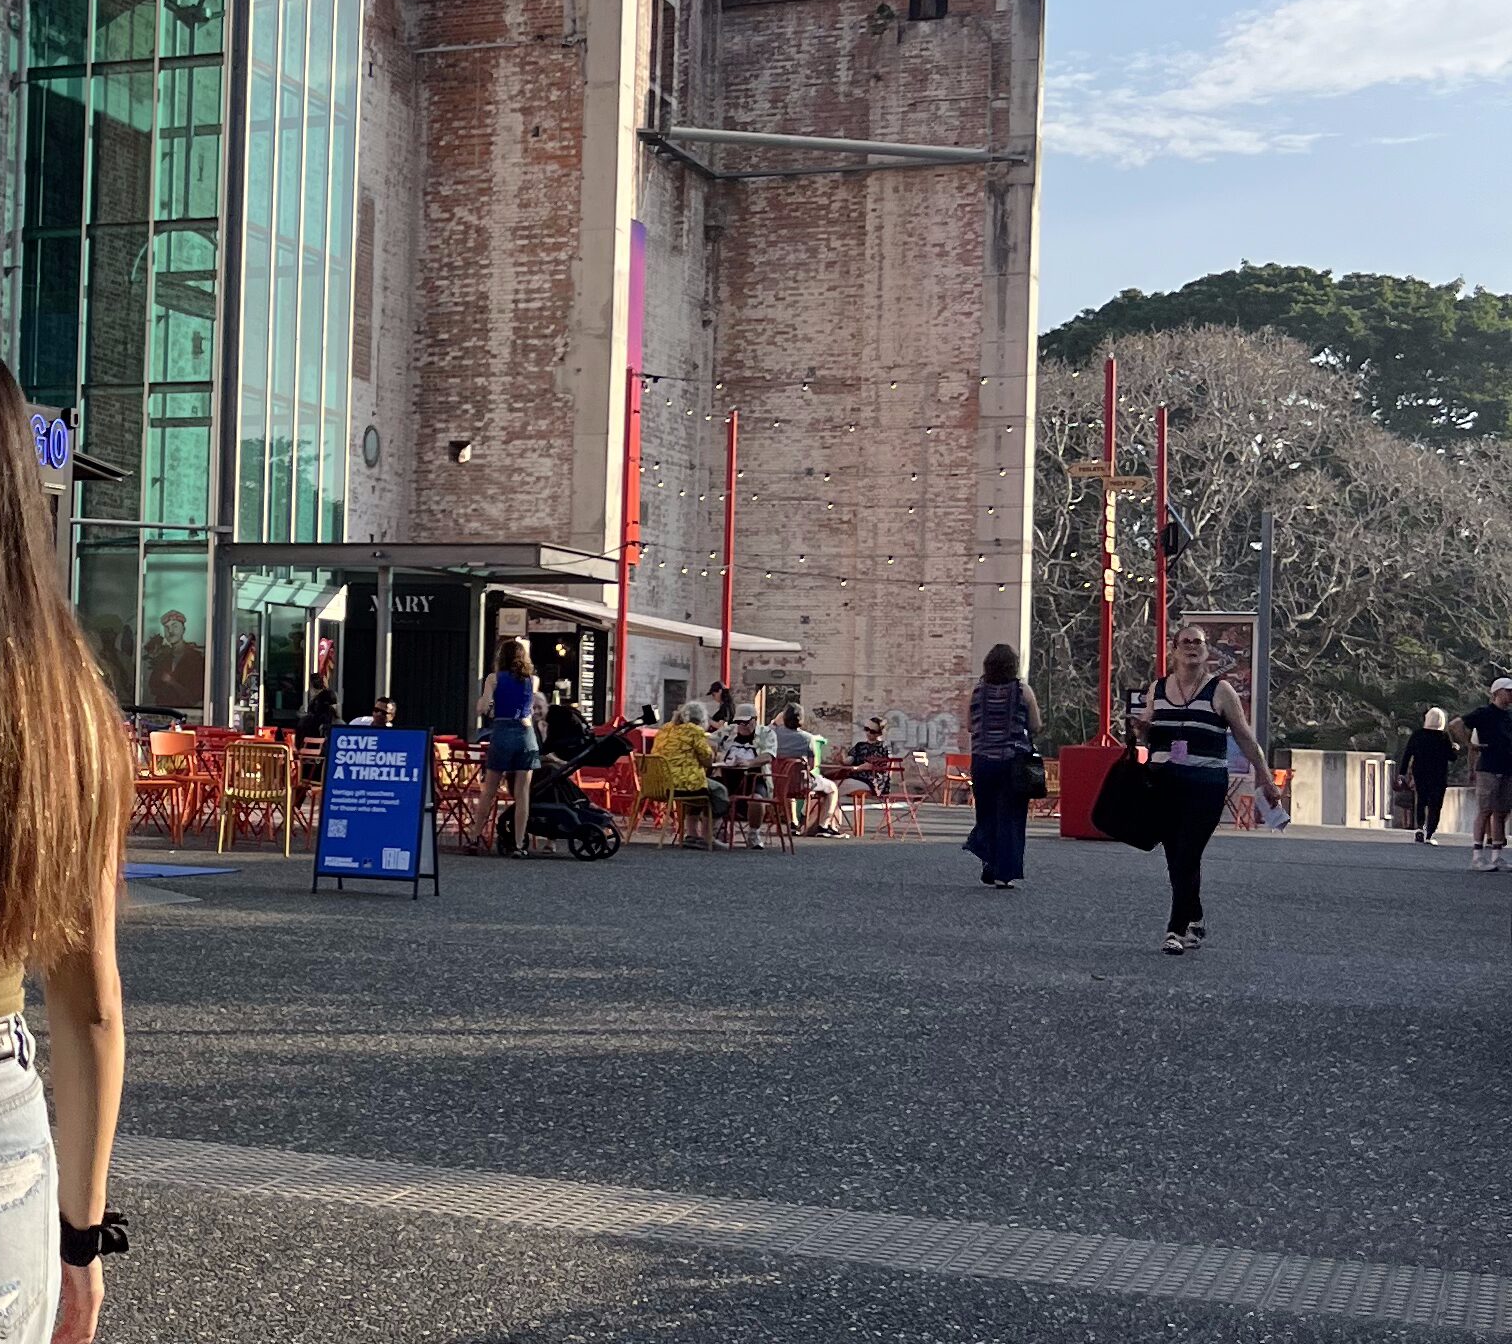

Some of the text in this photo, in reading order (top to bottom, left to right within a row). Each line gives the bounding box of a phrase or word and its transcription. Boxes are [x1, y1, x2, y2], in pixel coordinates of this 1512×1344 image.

[337, 735, 378, 750] GIVE
[334, 750, 407, 766] SOMEONE
[333, 765, 345, 780] A
